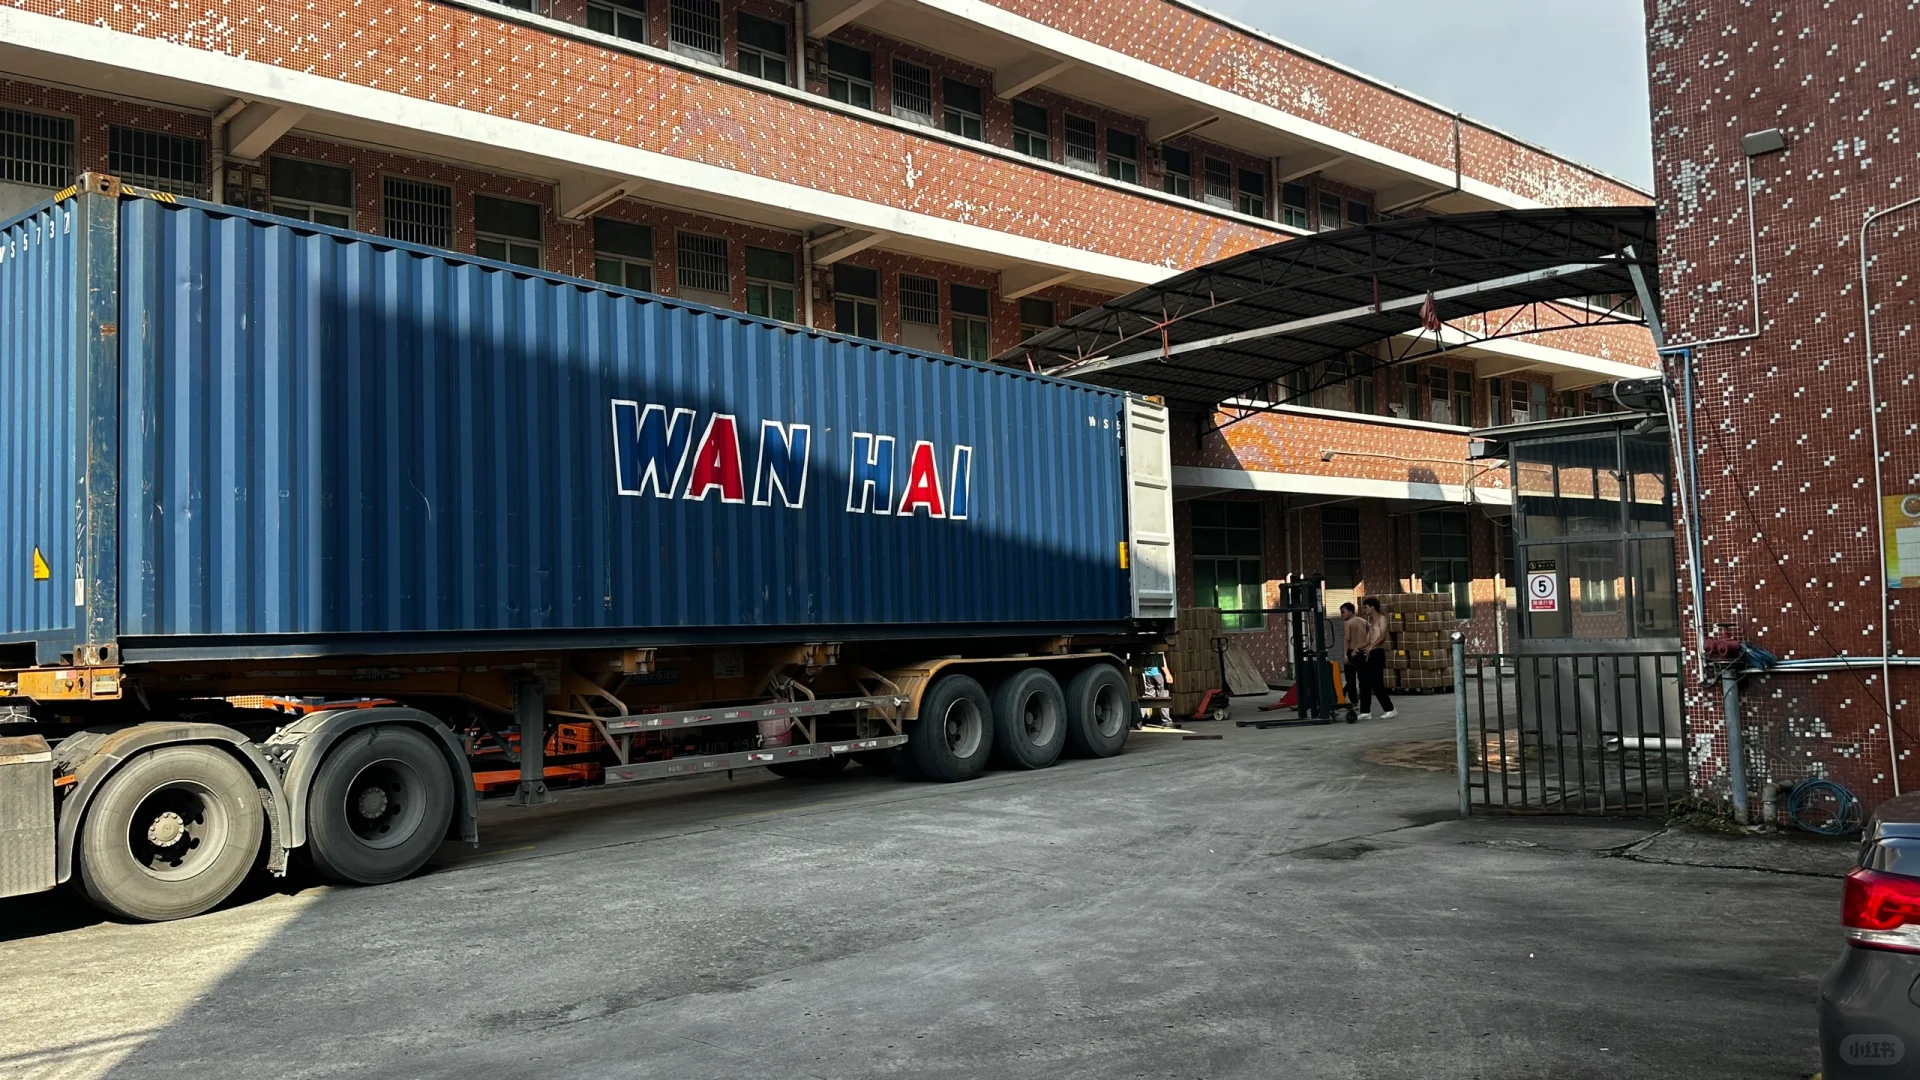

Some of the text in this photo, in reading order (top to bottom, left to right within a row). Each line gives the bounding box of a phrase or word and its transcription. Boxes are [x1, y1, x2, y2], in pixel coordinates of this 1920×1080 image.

[611, 398, 972, 520] WAN HAI
[1538, 580, 1547, 593] 5
